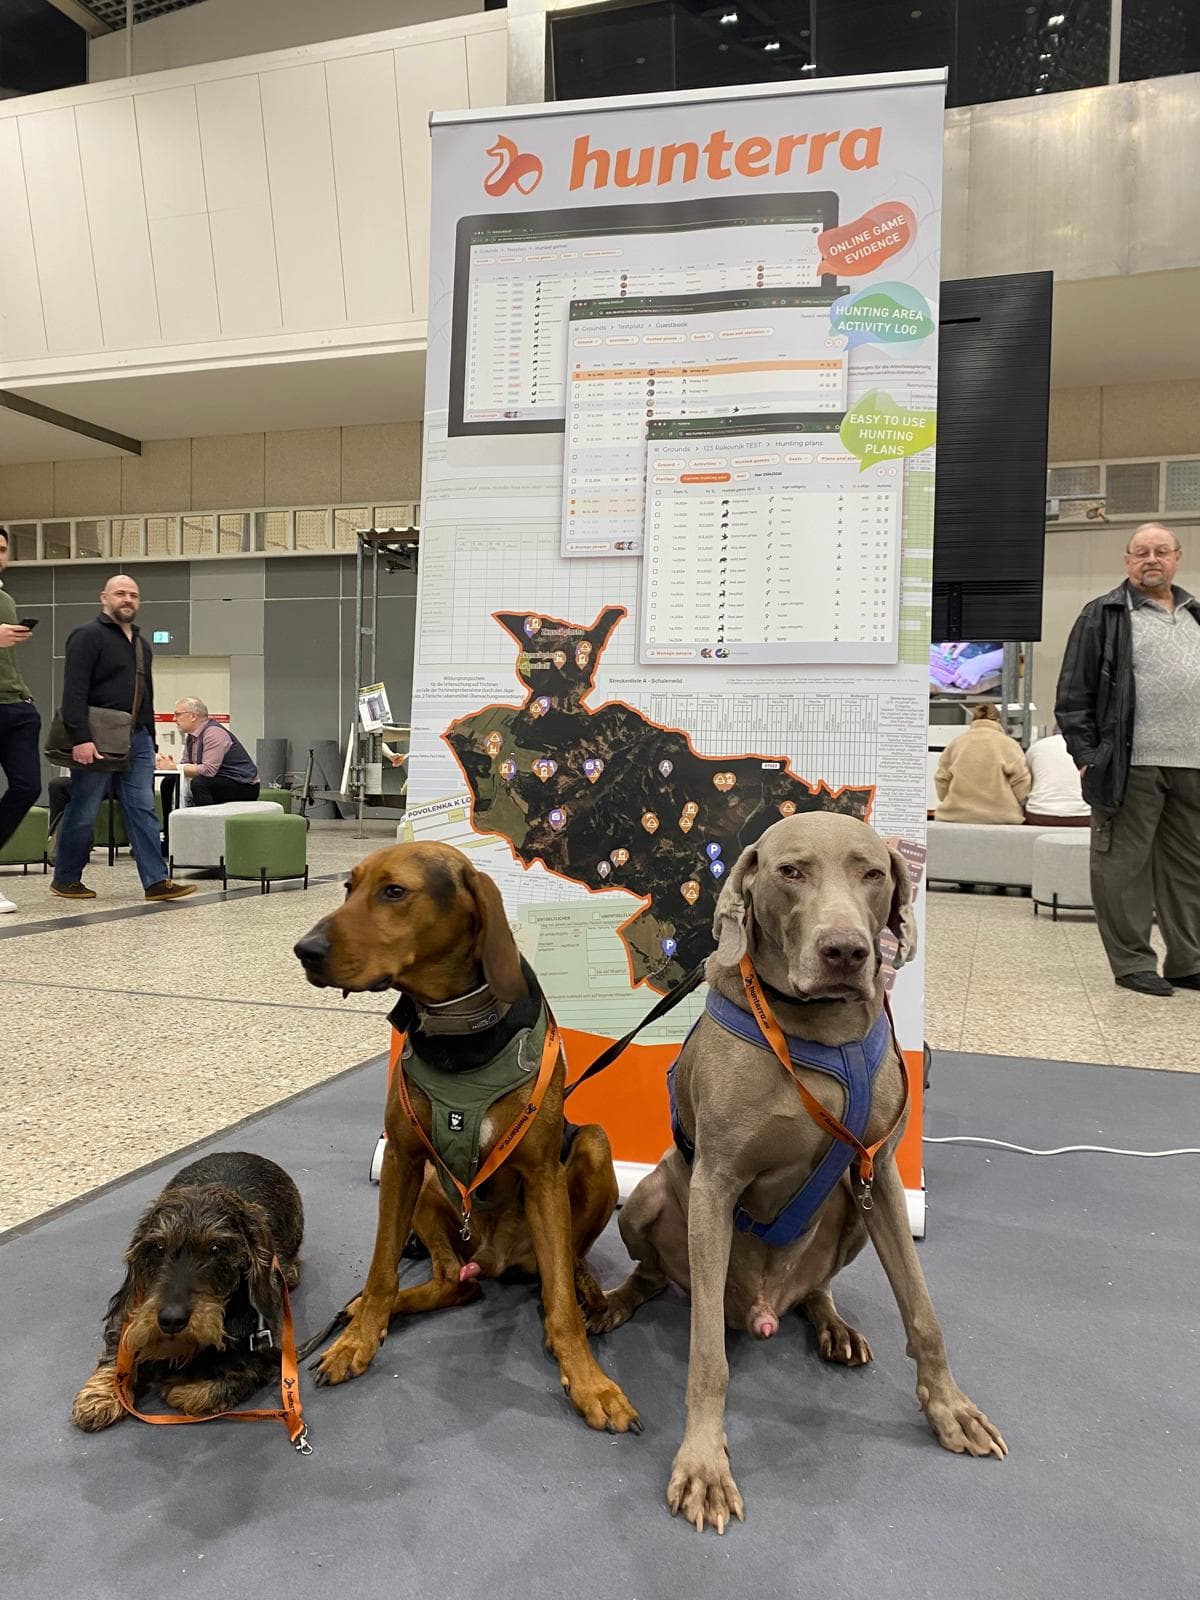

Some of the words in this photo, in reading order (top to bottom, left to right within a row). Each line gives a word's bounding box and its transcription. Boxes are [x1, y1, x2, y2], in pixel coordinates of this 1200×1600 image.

[569, 126, 883, 192] hunterra
[829, 230, 872, 256] ONLINE
[872, 215, 907, 236] GAME
[844, 232, 901, 264] EVIDENCE
[835, 306, 889, 318] HUNTING
[891, 308, 924, 321] AREA
[655, 321, 688, 329] Guestbook
[837, 321, 892, 333] ACTIVITY
[894, 323, 918, 335] LOG
[849, 413, 880, 424] EASY
[884, 415, 899, 425] TO
[902, 416, 926, 428] USE
[859, 428, 914, 441] HUNTING
[662, 445, 691, 453] Grounds
[746, 441, 762, 449] TEST
[775, 440, 803, 449] Hunting
[804, 440, 823, 448] plans
[865, 443, 905, 456] PLANS
[407, 801, 453, 819] POVOLENKA
[454, 799, 460, 807] K
[710, 844, 719, 854] P
[666, 939, 674, 950] P
